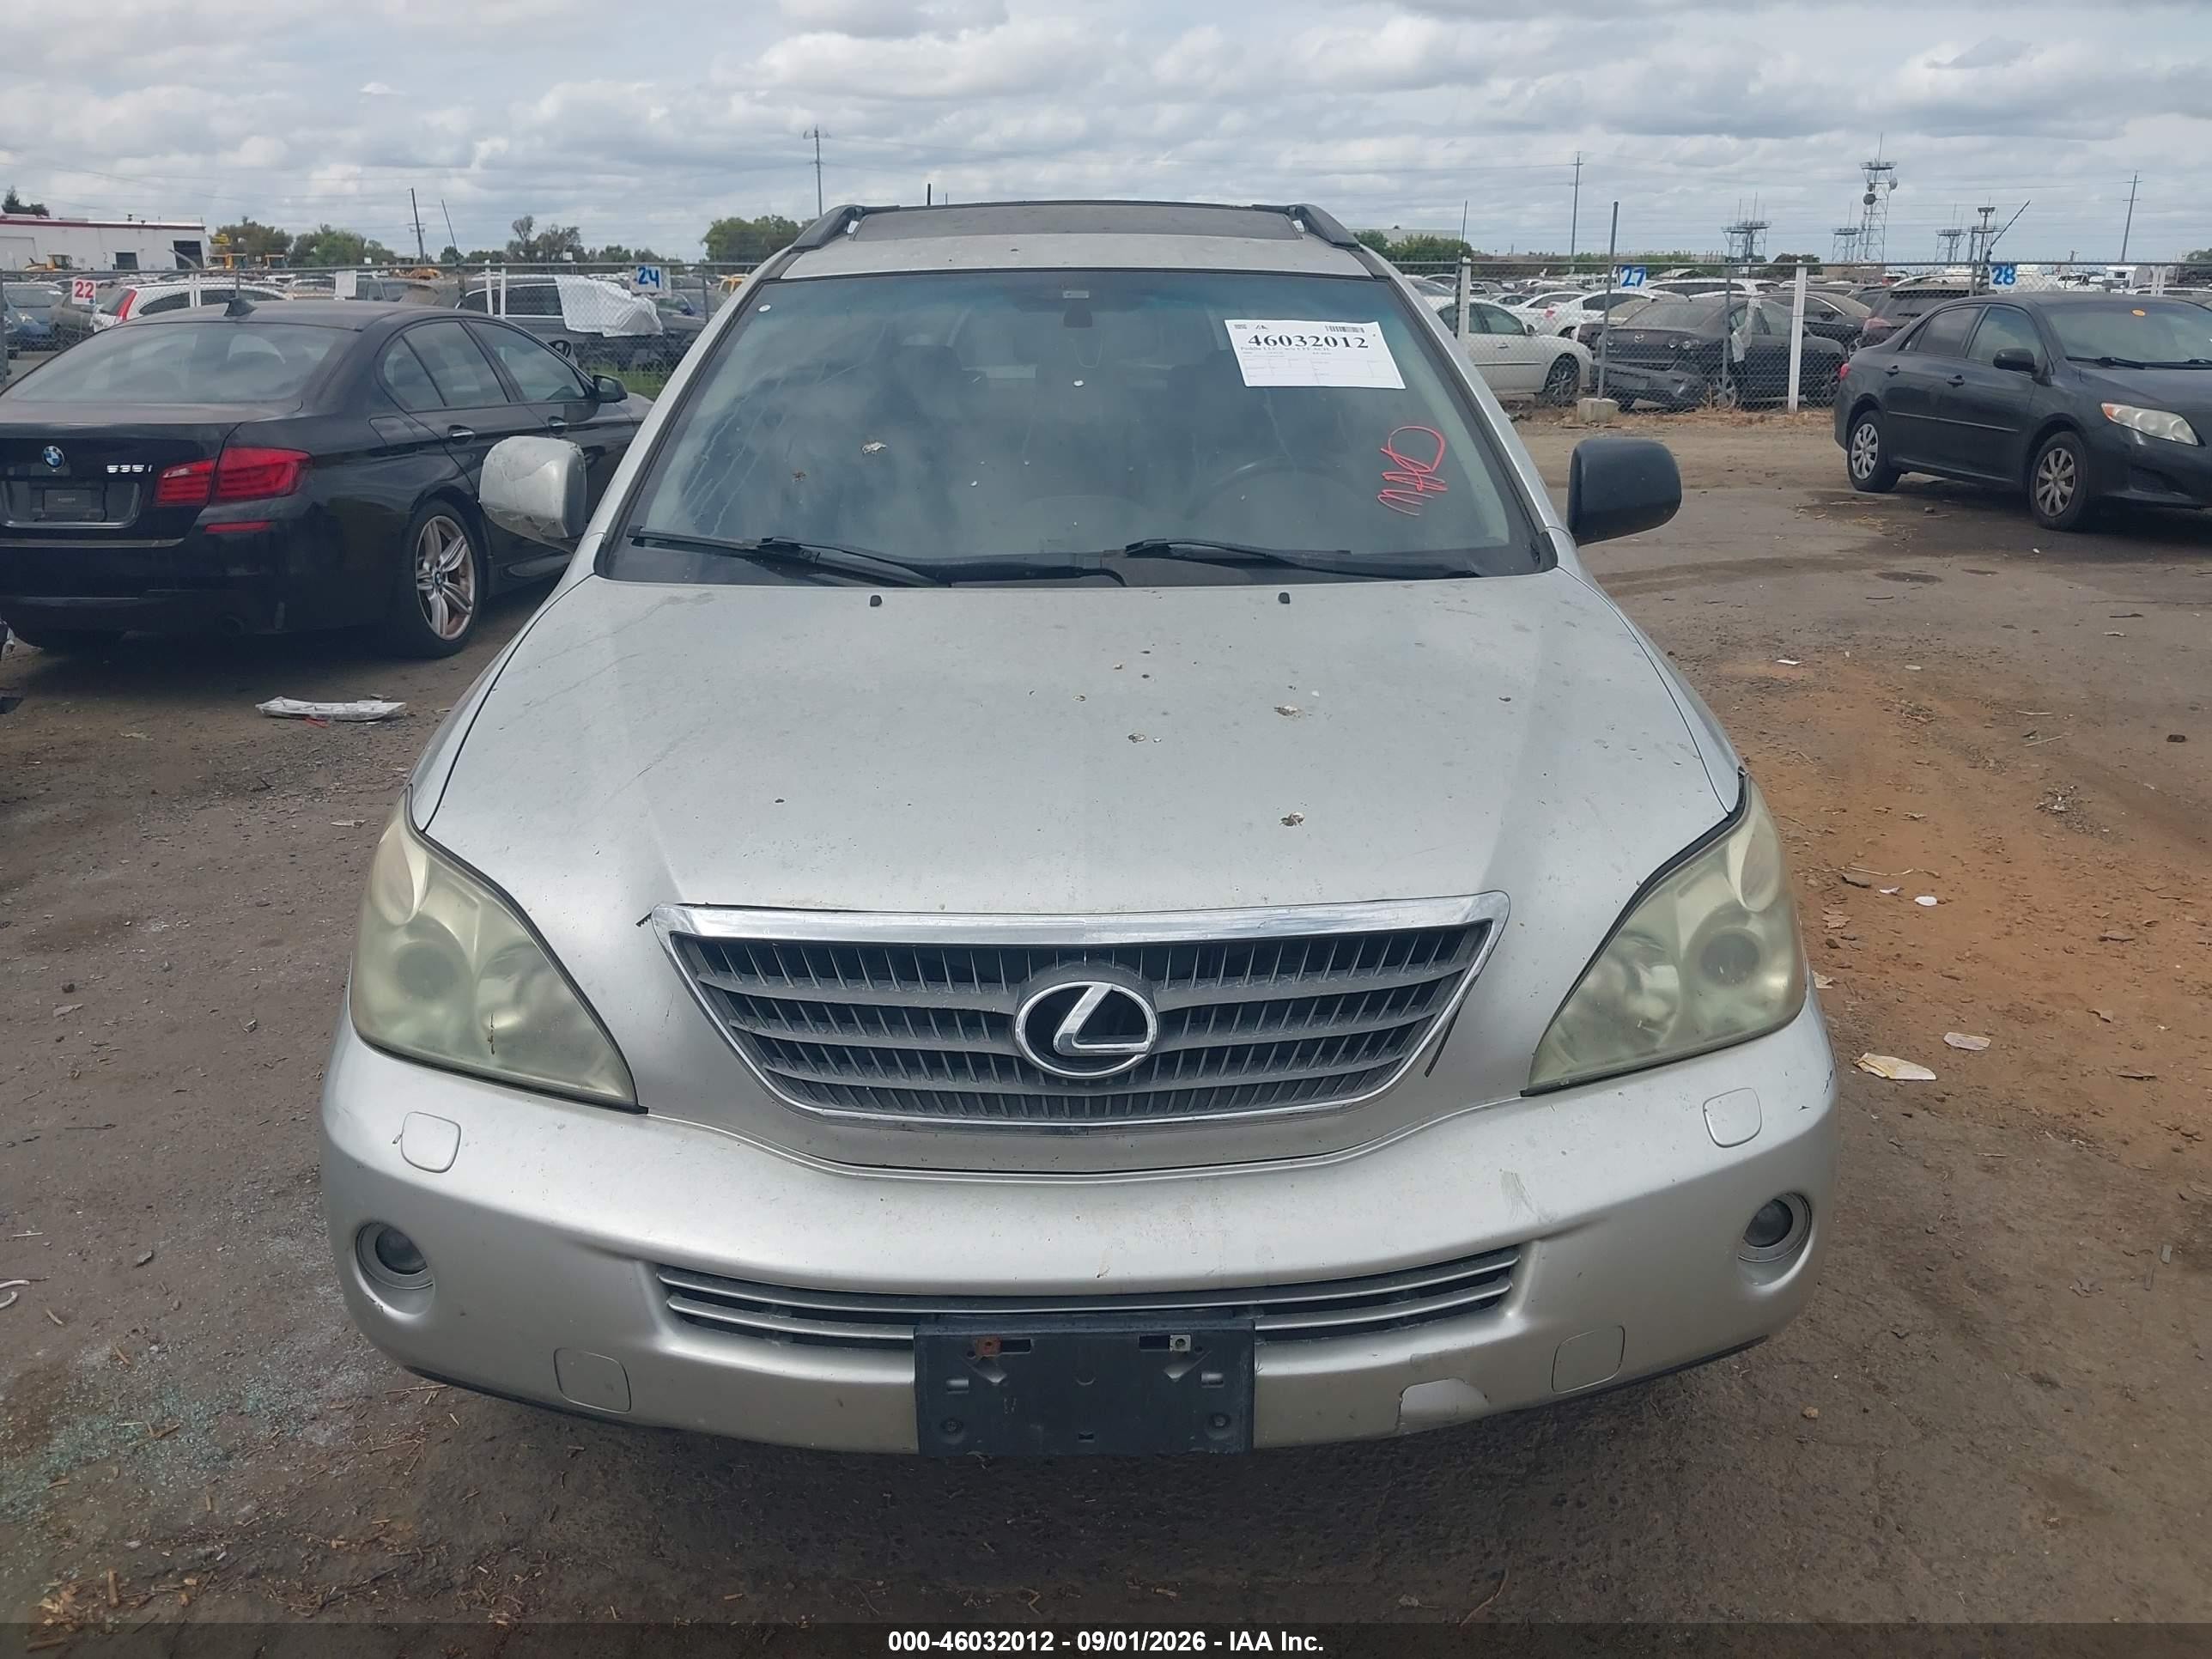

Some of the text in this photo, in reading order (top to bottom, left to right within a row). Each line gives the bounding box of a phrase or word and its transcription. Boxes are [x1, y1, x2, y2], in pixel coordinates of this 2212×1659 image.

[637, 266, 659, 289] 24
[1620, 265, 1645, 288] 27
[1991, 266, 2016, 285] 28
[75, 281, 94, 299] 22
[1248, 334, 1370, 349] 46032012
